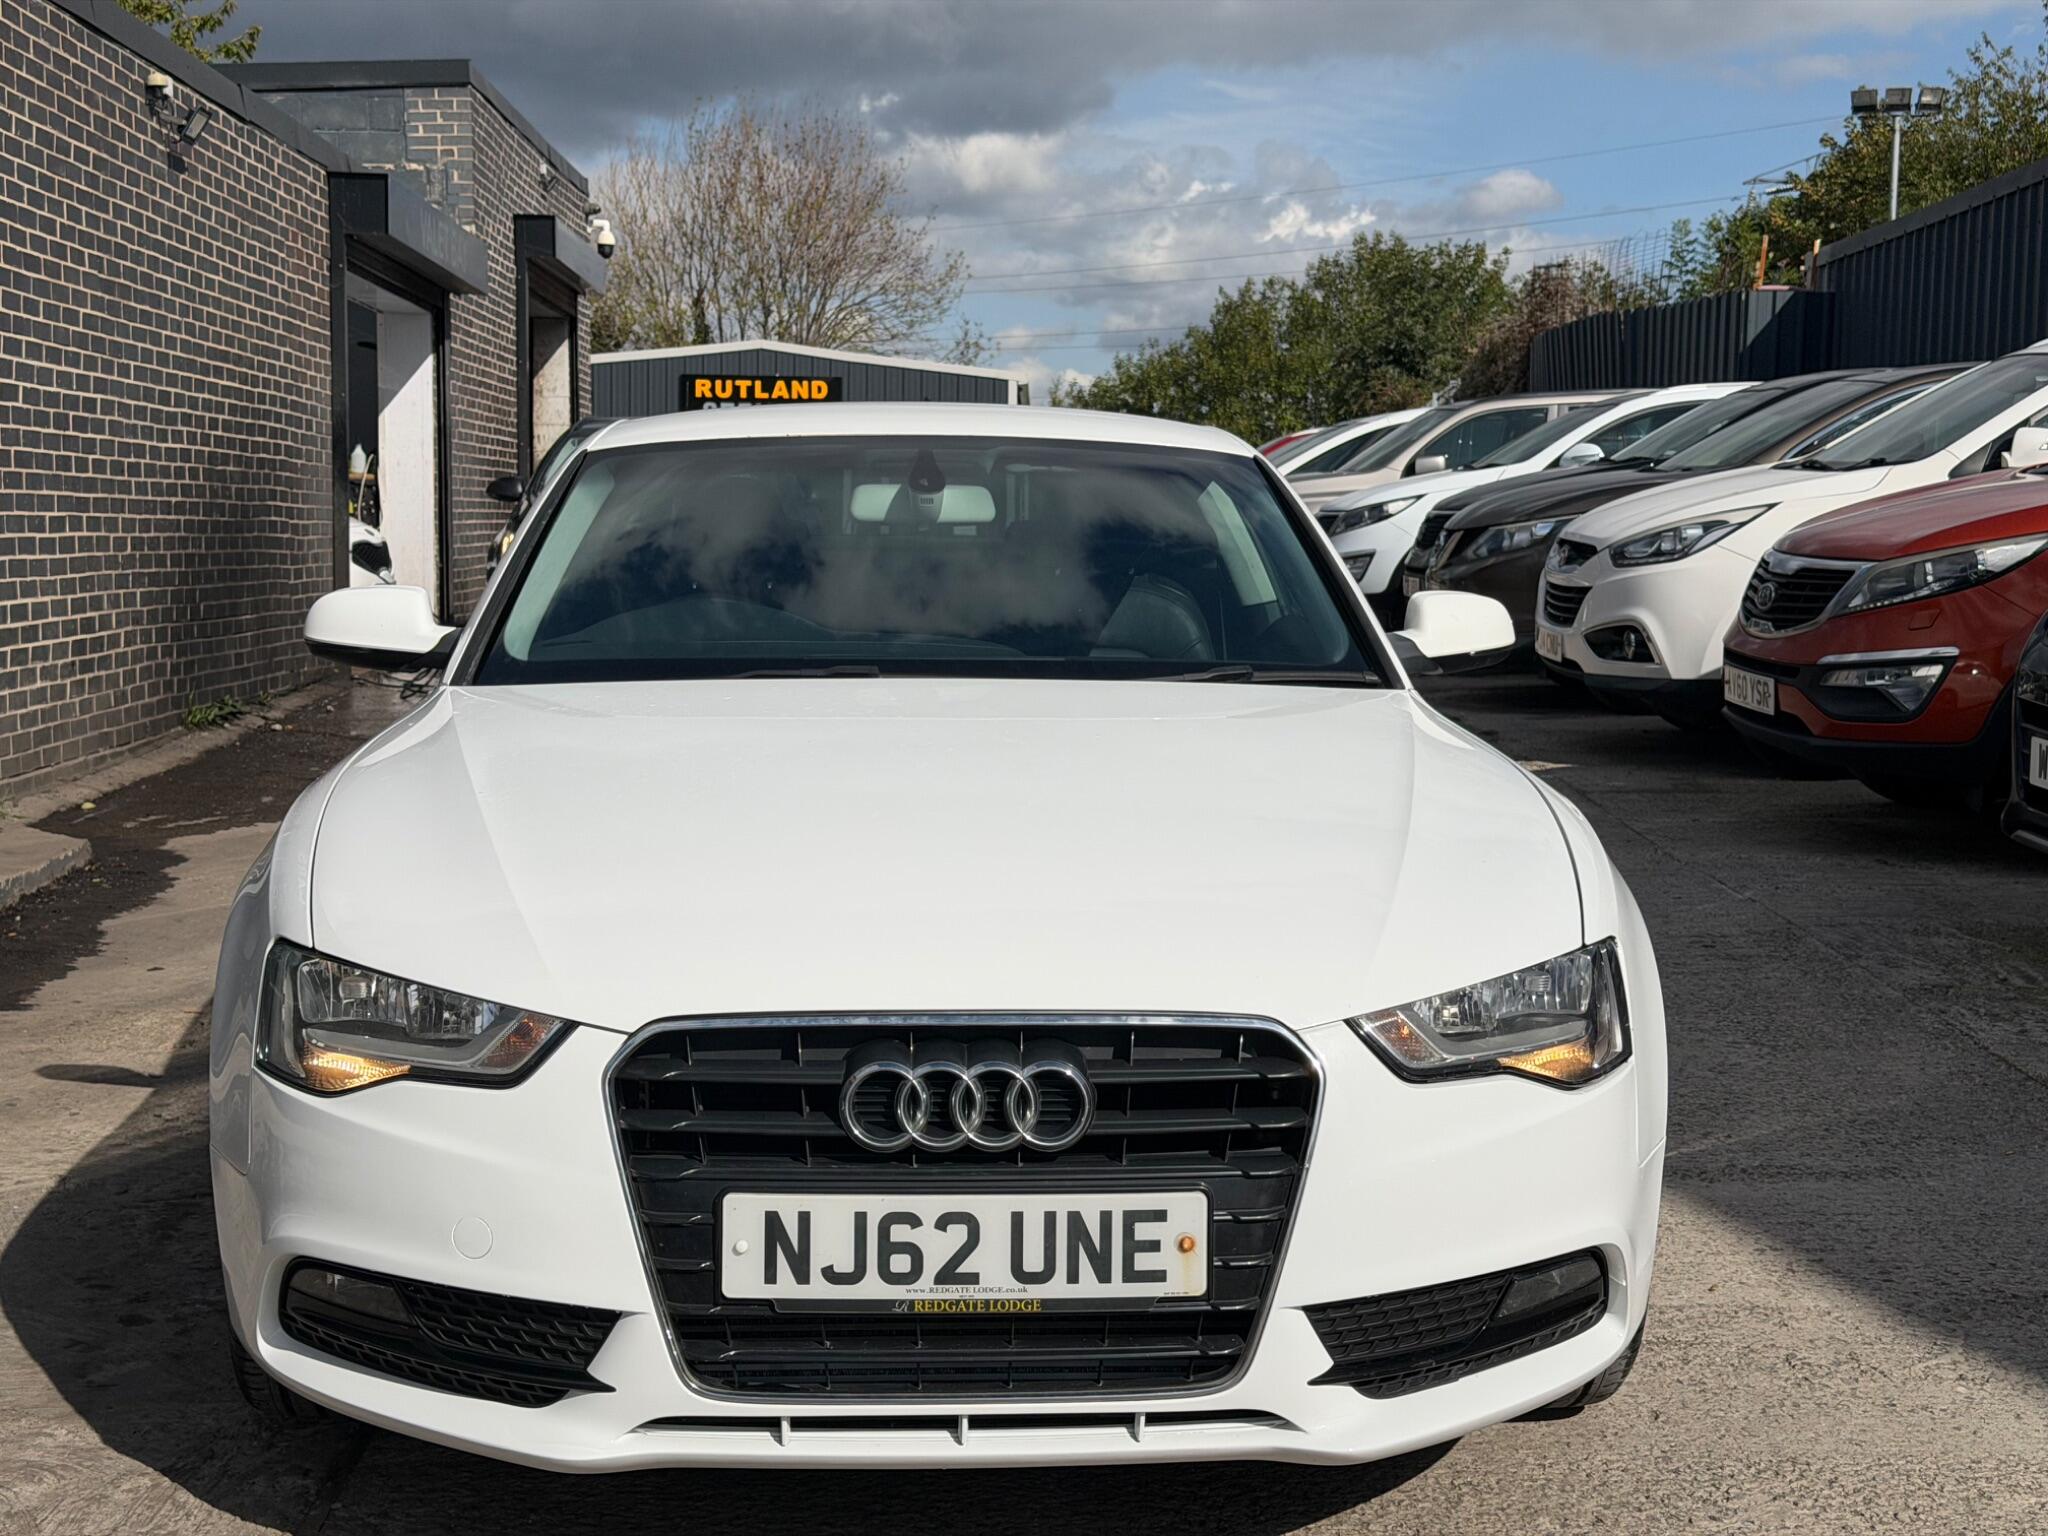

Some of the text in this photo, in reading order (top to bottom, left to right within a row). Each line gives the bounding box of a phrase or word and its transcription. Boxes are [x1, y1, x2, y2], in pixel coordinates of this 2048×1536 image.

[695, 379, 828, 399] RUTLAND
[764, 1208, 1168, 1286] NJ62 UNE
[914, 1300, 985, 1312] REDGATE
[989, 1300, 1042, 1312] LODGE
